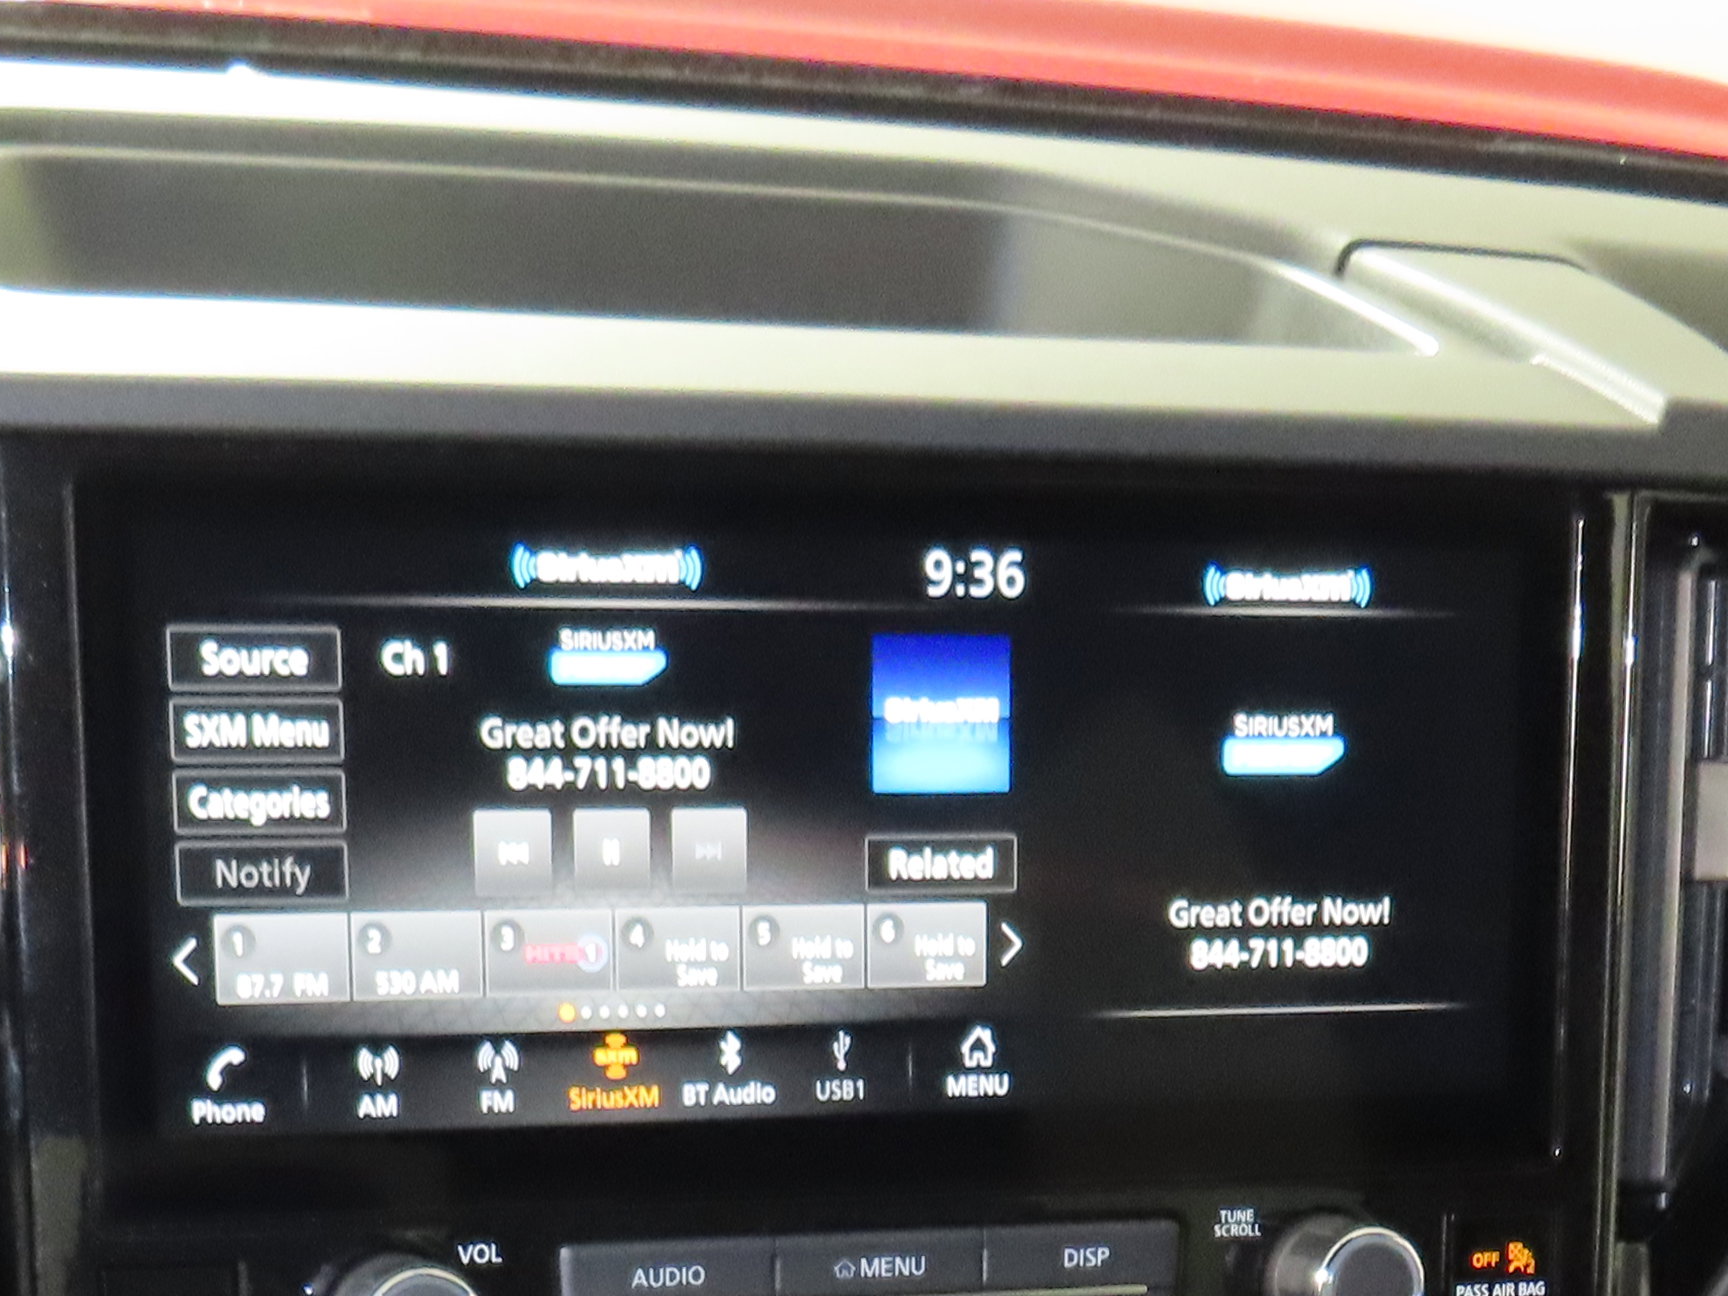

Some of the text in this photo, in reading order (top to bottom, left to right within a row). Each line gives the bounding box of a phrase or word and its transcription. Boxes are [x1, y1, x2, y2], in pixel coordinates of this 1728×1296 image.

[925, 548, 1026, 599] 9:36
[200, 639, 309, 676] Source
[381, 639, 449, 676] Ch 1
[183, 713, 330, 748] SXM Menu
[479, 714, 735, 749] Great Offer Now!
[506, 755, 711, 790] 844-711-8800
[187, 783, 331, 827] Categories
[215, 856, 311, 896] Notify
[888, 846, 995, 880] Related
[1169, 896, 1390, 928] Great Offer Now!
[232, 930, 244, 957] 1
[367, 928, 382, 954] 2
[500, 924, 515, 951] 3
[629, 923, 645, 948] 4
[756, 919, 771, 946] 5
[880, 918, 896, 943] 6
[665, 937, 729, 962] Hold to
[1190, 936, 1368, 970] 844-711-8800
[293, 972, 329, 997] FM
[419, 969, 460, 995] AM
[676, 963, 718, 988] Save
[569, 1085, 660, 1111] SiriusXM
[682, 1080, 776, 1106] BT Audio
[816, 1079, 866, 1101] USB1
[946, 1072, 1010, 1098] MENU
[191, 1098, 266, 1125] Phone
[357, 1093, 400, 1119] AM
[479, 1088, 515, 1114] FM
[1219, 1208, 1255, 1224] TUNE
[1214, 1222, 1262, 1238] SCROLL
[458, 1243, 503, 1265] VOL
[859, 1255, 926, 1278] MENU
[1063, 1247, 1110, 1269] DISP
[1471, 1251, 1500, 1269] OFF
[631, 1265, 706, 1288] AUDIO
[1518, 1280, 1546, 1296] BAG
